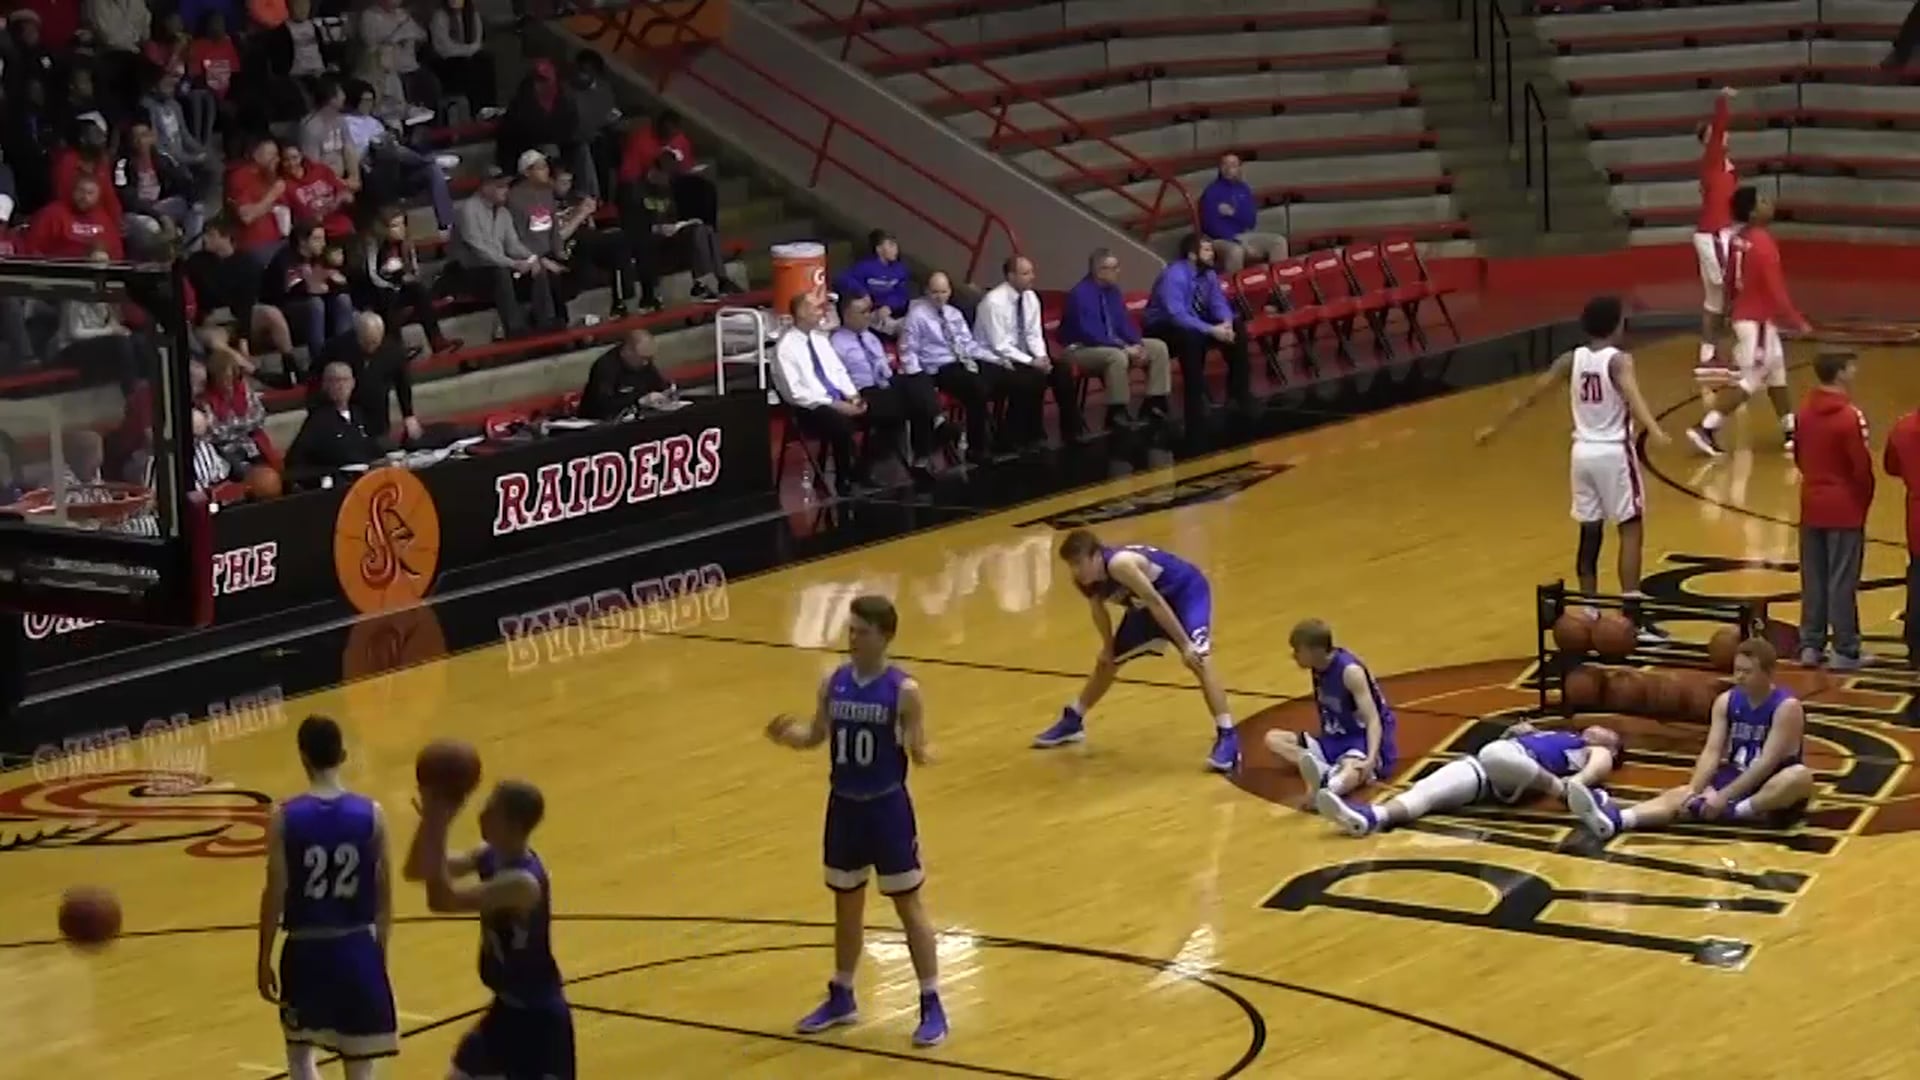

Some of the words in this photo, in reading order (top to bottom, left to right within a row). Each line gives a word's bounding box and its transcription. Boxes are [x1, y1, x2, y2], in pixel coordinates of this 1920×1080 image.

[1580, 370, 1603, 404] 30
[493, 428, 721, 536] RAIDERS
[835, 727, 876, 766] 10
[303, 843, 361, 899] 22
